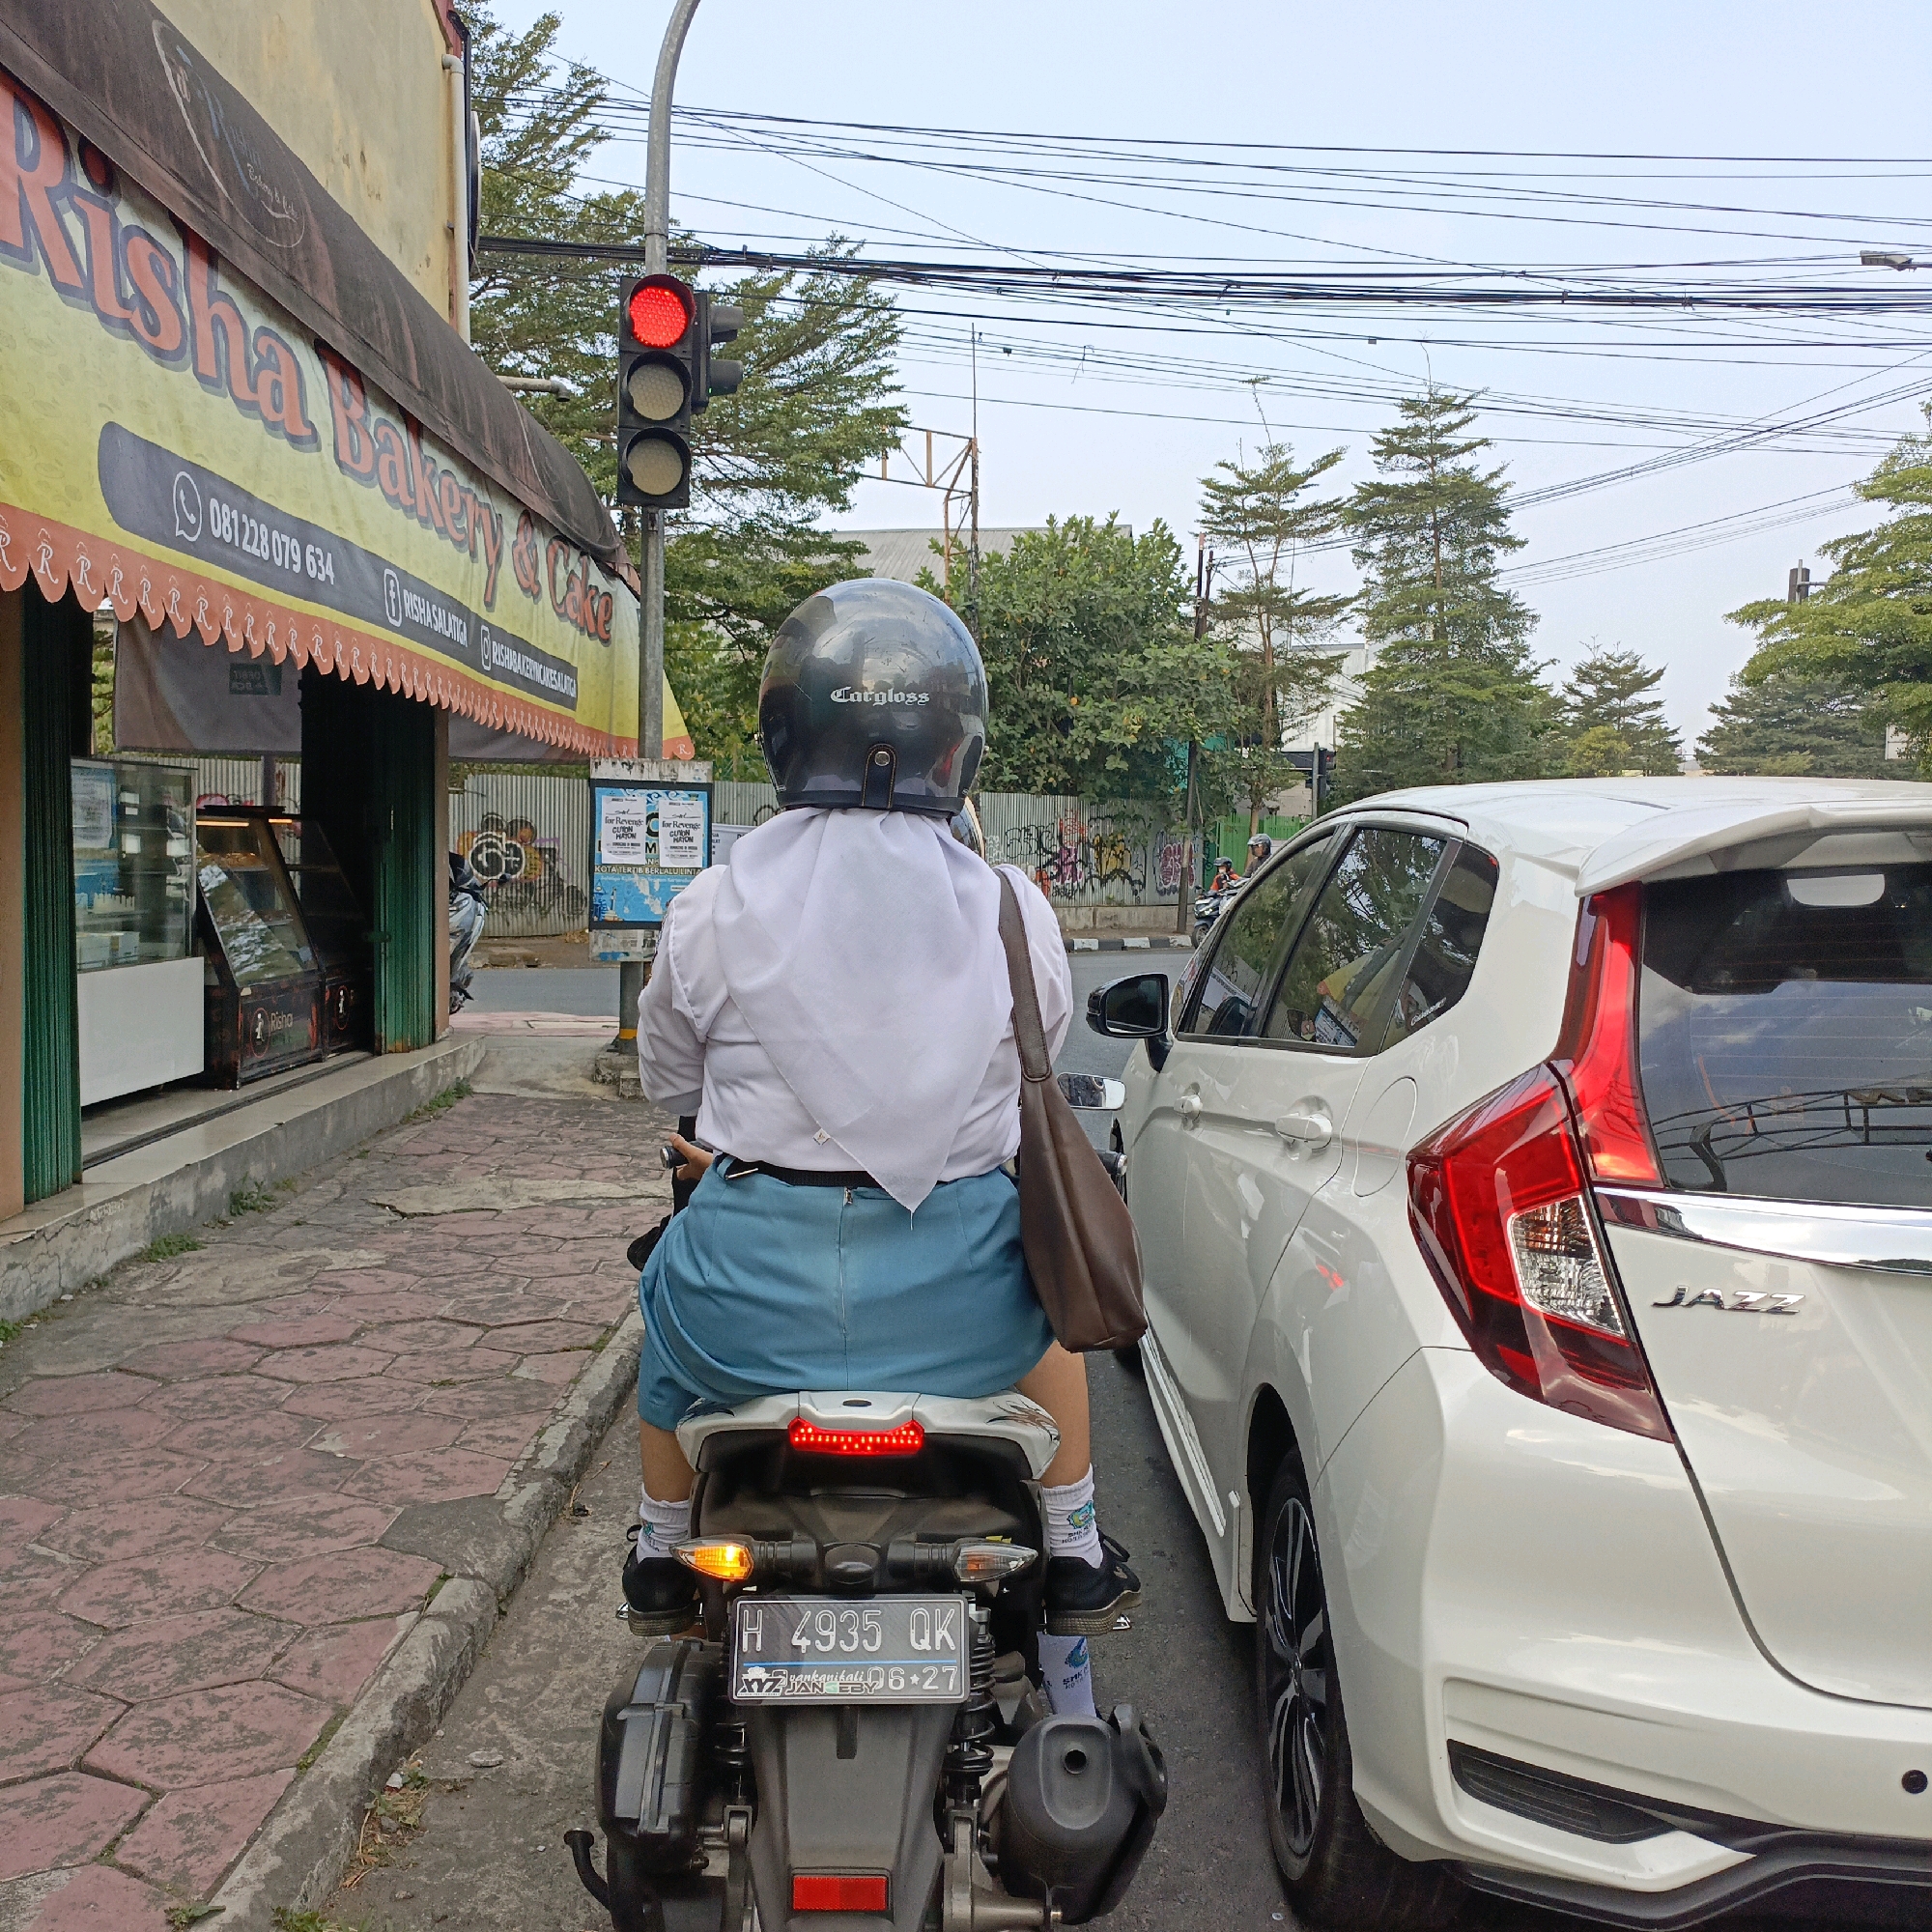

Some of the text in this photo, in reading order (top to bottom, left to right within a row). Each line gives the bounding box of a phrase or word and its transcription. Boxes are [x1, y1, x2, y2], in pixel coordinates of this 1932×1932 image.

[0, 70, 320, 450] Risha
[314, 339, 504, 611] Bakery
[513, 509, 542, 603] &
[546, 535, 612, 644] Cake
[272, 530, 301, 573] 079
[305, 544, 335, 584] 634
[37, 544, 58, 583] R
[76, 554, 97, 594] R
[111, 567, 128, 605] R
[140, 579, 156, 613] R
[168, 587, 185, 622] R
[196, 596, 212, 630] R
[223, 606, 236, 638] R
[244, 613, 257, 644] R
[266, 621, 279, 651] R
[289, 628, 300, 657] R
[312, 634, 327, 663] R
[335, 640, 345, 668] R
[351, 647, 363, 672] R
[371, 652, 380, 677] R
[386, 658, 395, 682] R
[831, 686, 929, 706] Cargloss
[615, 816, 644, 826] Revenge
[673, 820, 701, 830] Revenge
[619, 866, 643, 874] TERTIB
[645, 867, 680, 875] BERLALU
[1651, 1285, 1805, 1315] JAZZ
[742, 1607, 956, 1653] H 4935 QK
